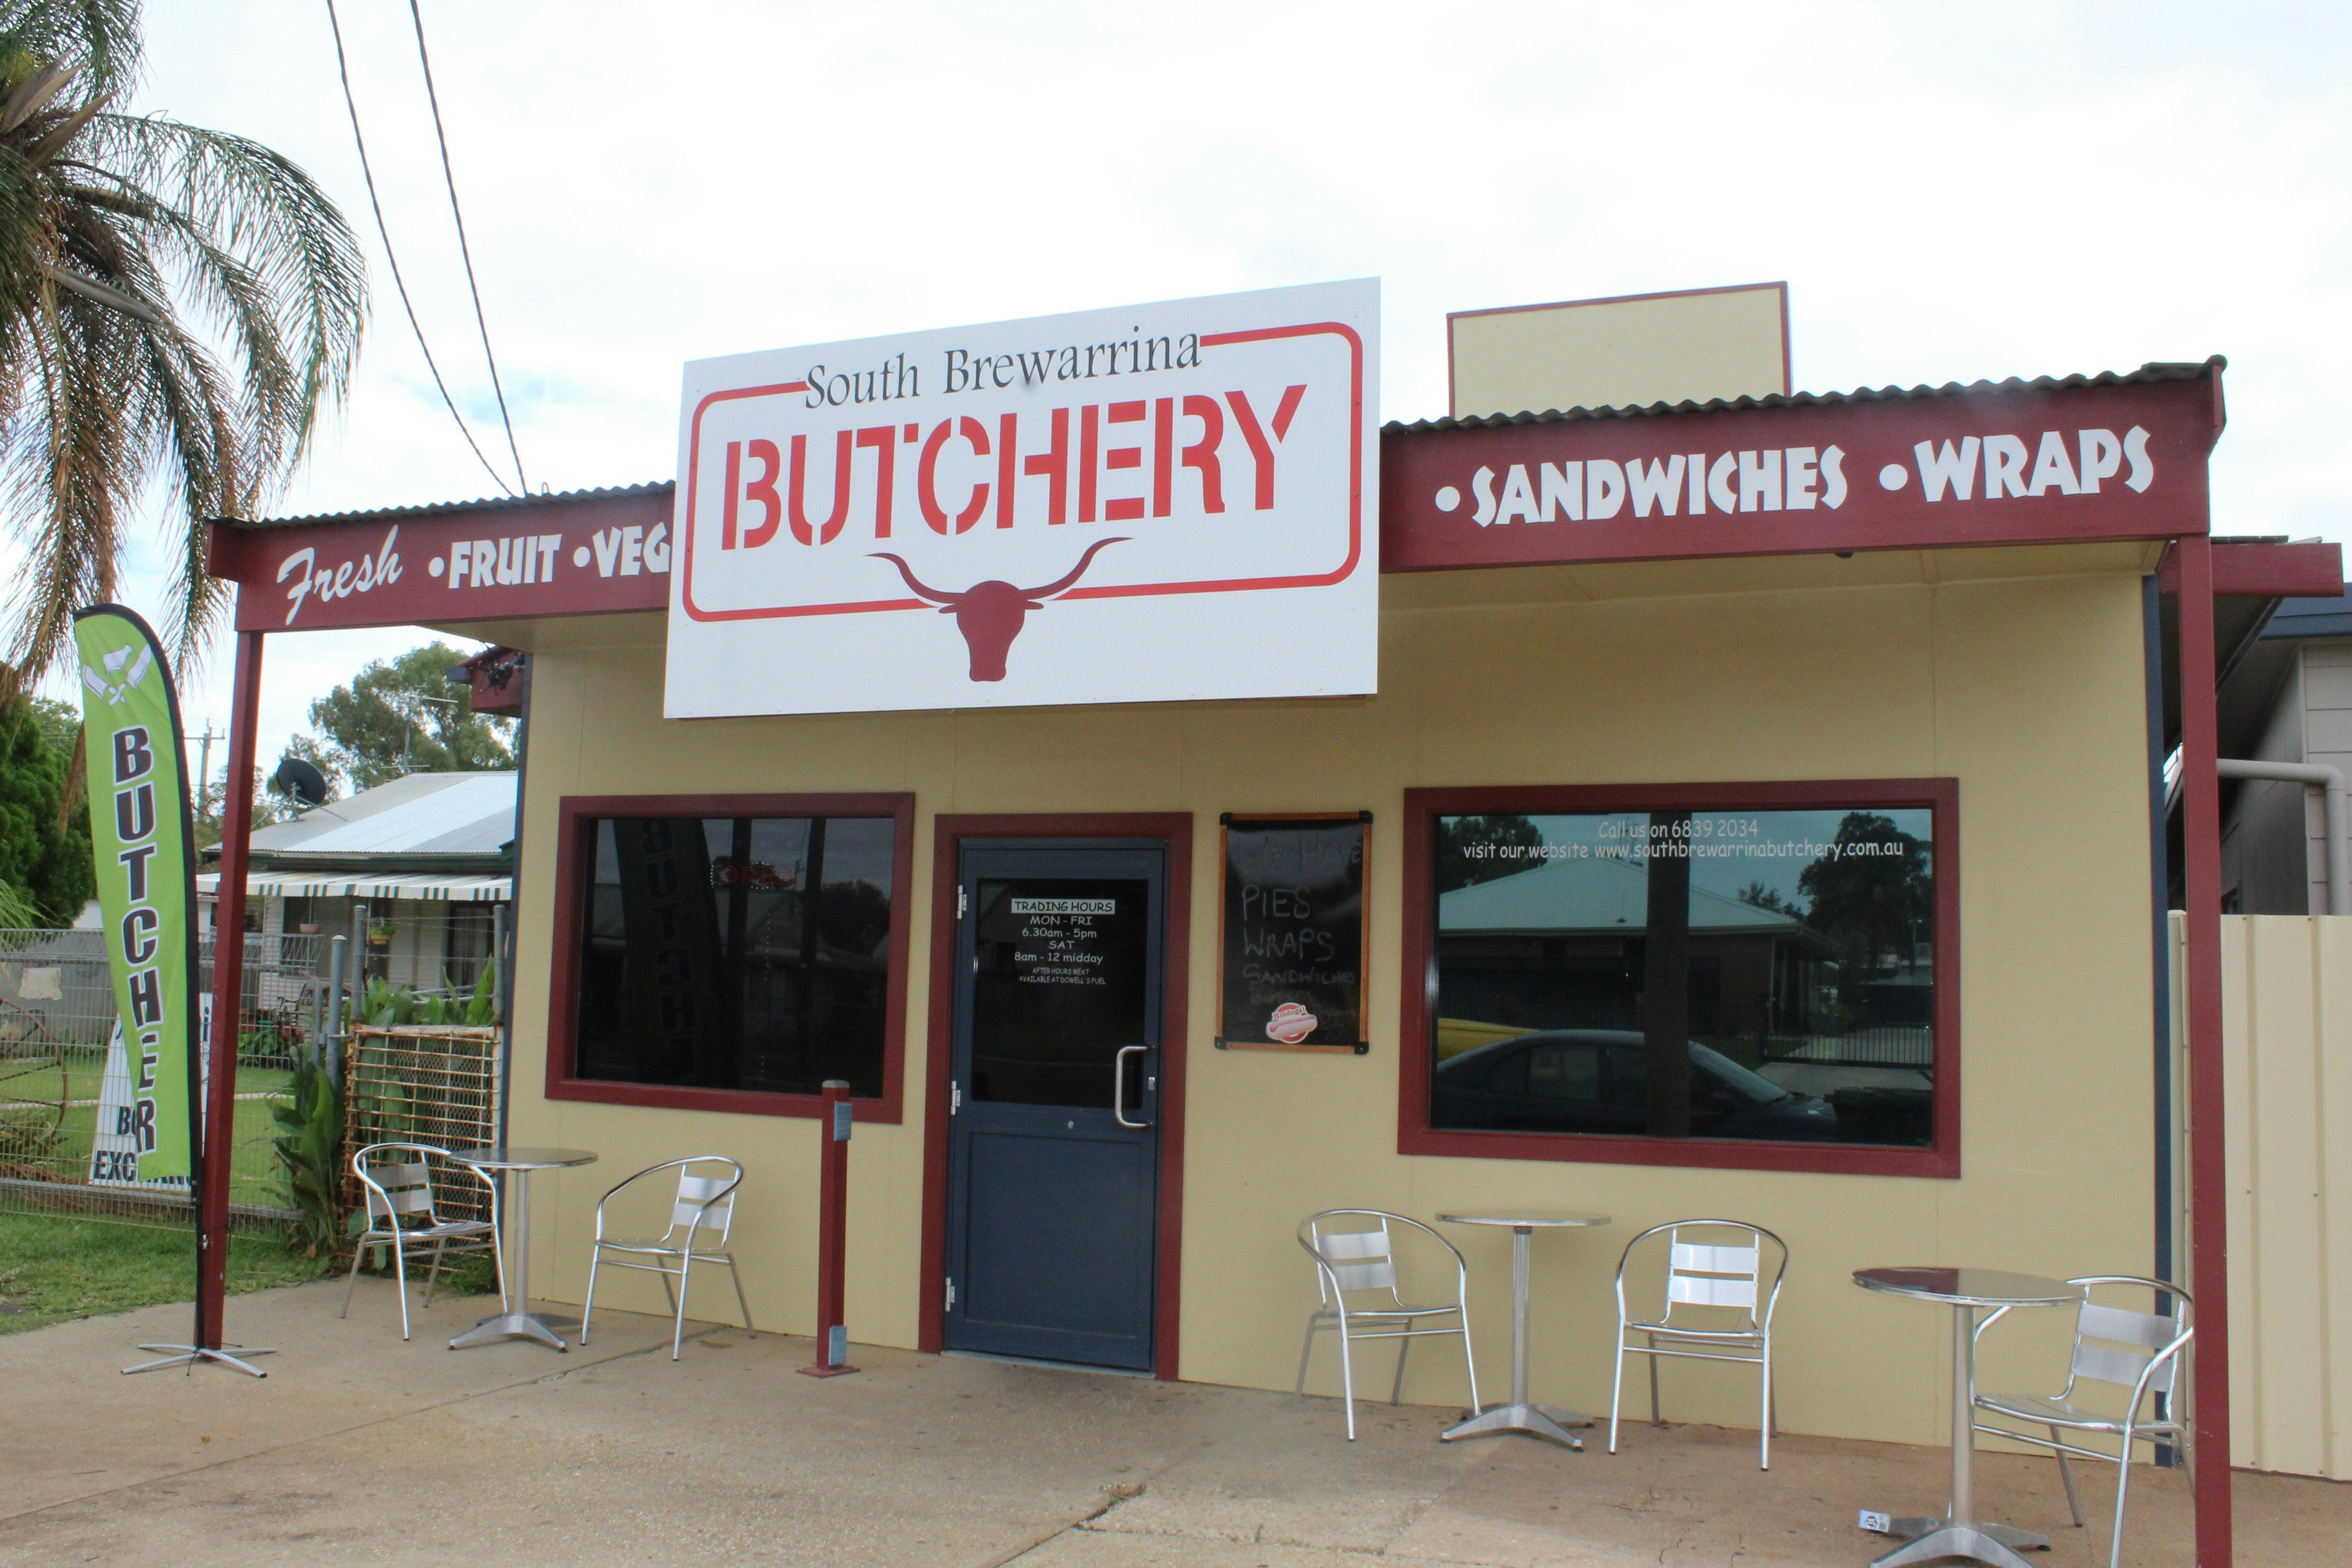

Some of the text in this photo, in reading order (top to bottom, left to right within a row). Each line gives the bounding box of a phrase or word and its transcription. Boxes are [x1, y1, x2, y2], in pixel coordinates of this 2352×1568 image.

[804, 325, 1202, 409] South Brewarrina
[721, 384, 1307, 551] BUTCHERY
[1472, 425, 2154, 527] SANDWICHES WRAPS
[277, 524, 403, 625] Fresh
[448, 534, 562, 589] FRUIT
[1599, 819, 1758, 838] Call us on 6839 2034
[1464, 839, 1903, 862] visit our website www.southbrewarrinabutchery.com.au
[1015, 901, 1112, 912] TRADING HOURS
[1242, 885, 1310, 921] PIES
[1030, 916, 1060, 925] MON
[1071, 916, 1092, 925] FRI
[112, 724, 164, 1155] BUTCHER
[1022, 928, 1063, 936] 6.30am
[1073, 929, 1097, 940] 5pm
[1049, 941, 1075, 950] SAT
[1014, 952, 1037, 961] 8am
[1048, 953, 1059, 961] 12
[1063, 953, 1103, 965] midday
